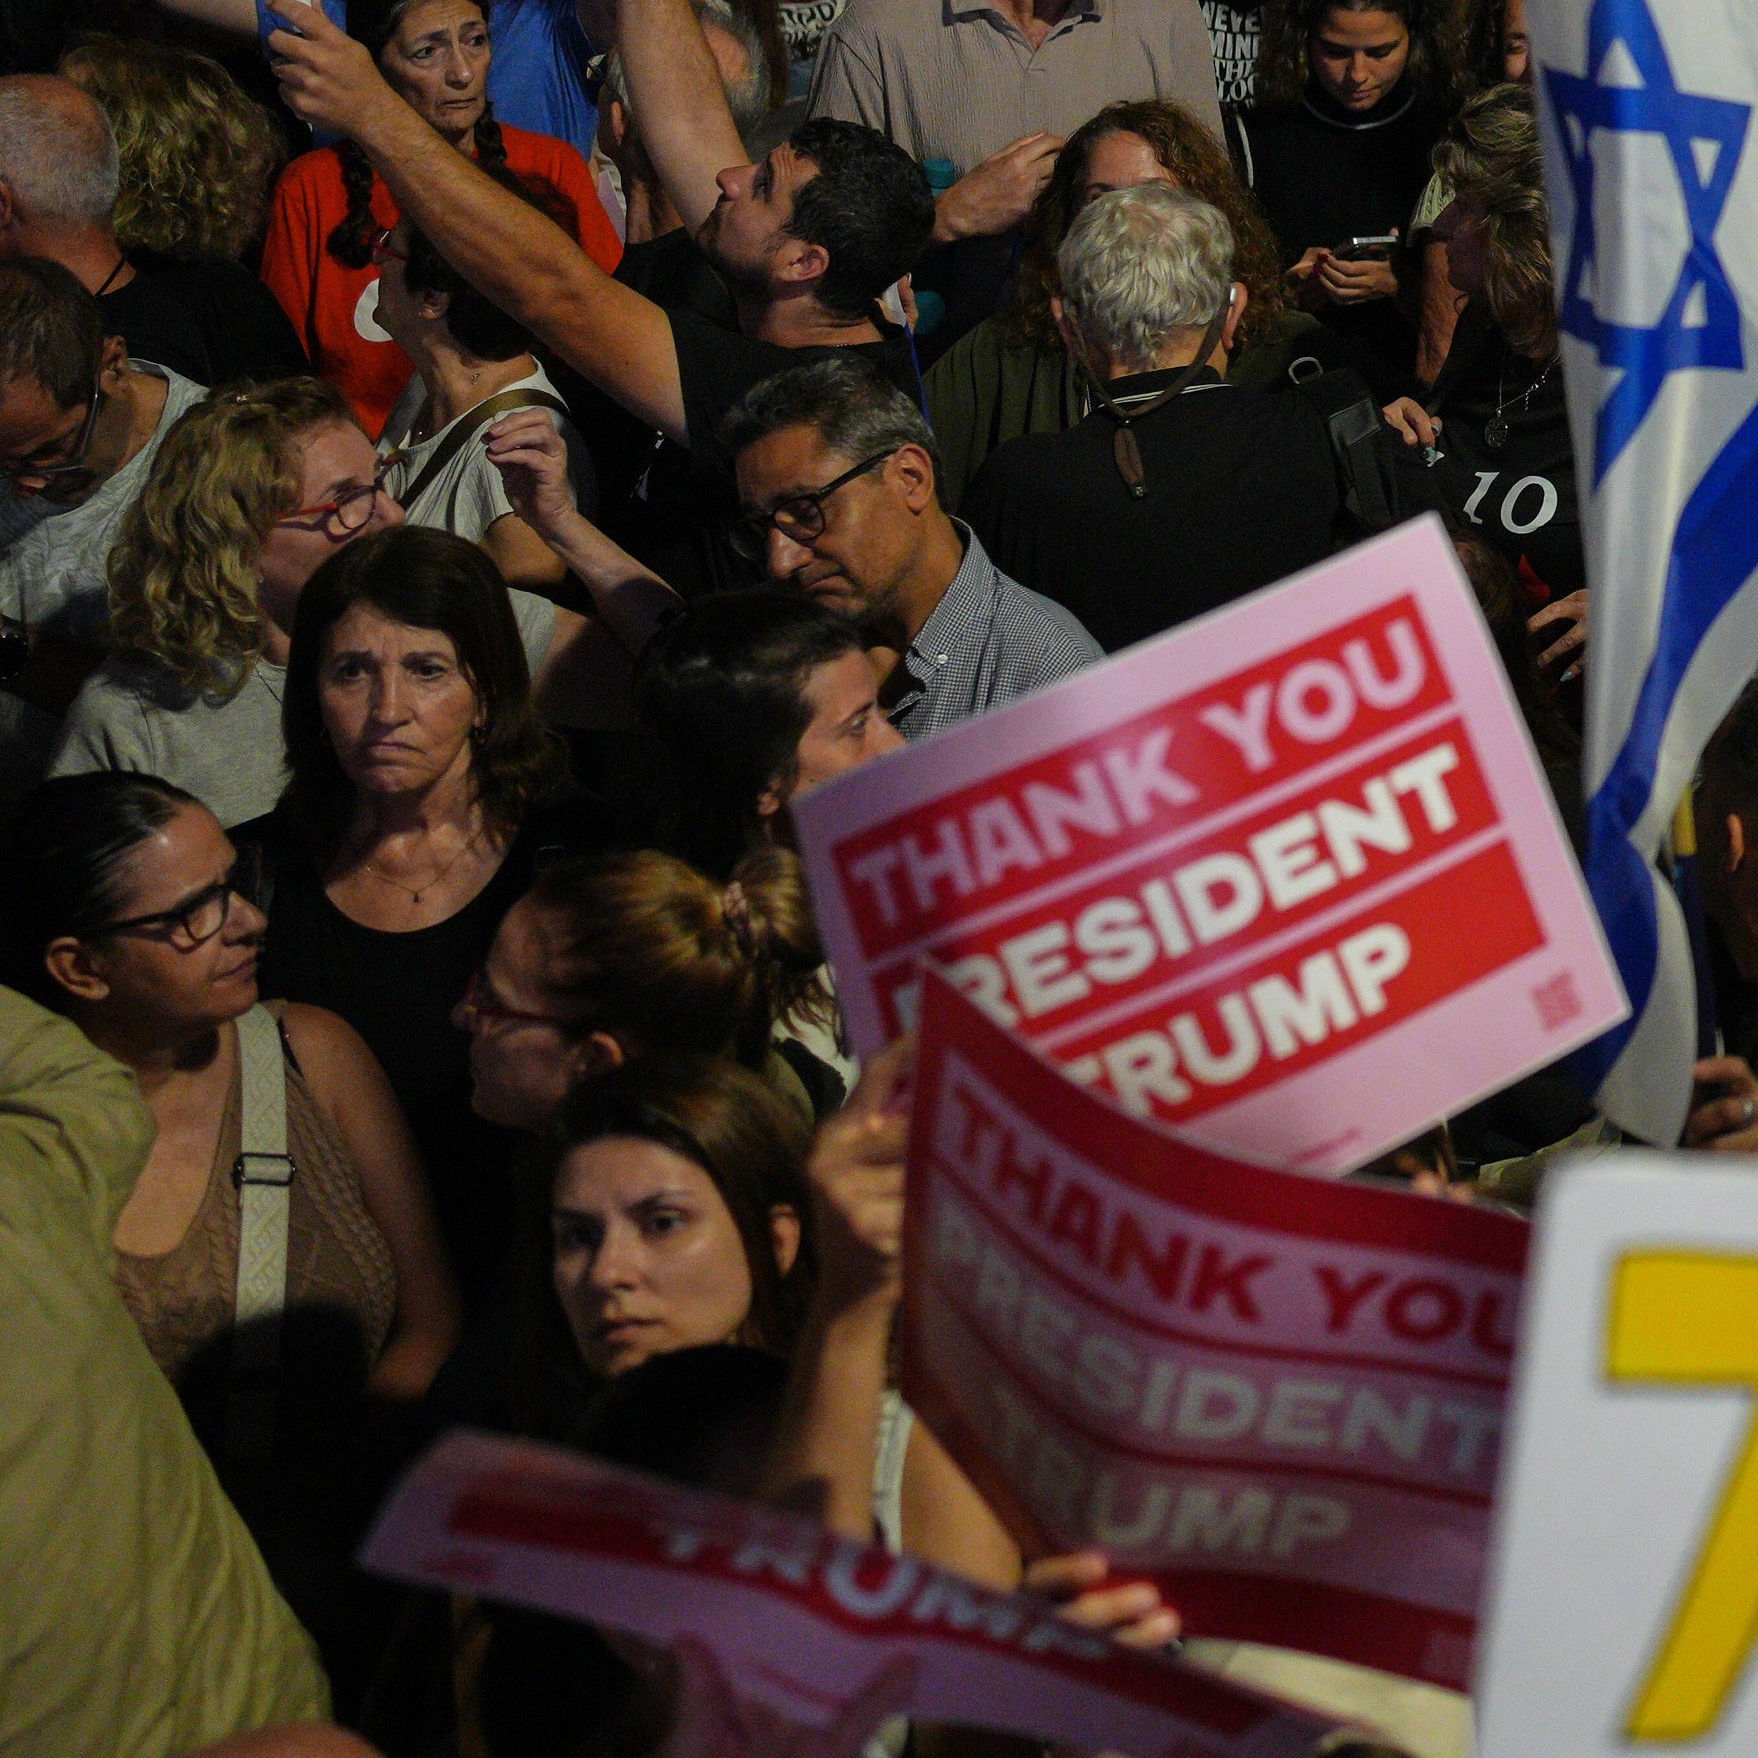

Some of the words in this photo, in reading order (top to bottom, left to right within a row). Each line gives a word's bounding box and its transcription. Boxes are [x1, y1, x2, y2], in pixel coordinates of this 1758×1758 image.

[1201, 1, 1260, 33] NEVE
[848, 724, 1199, 930] THANK
[1201, 617, 1432, 774] YOU
[950, 1087, 1276, 1328] THANK
